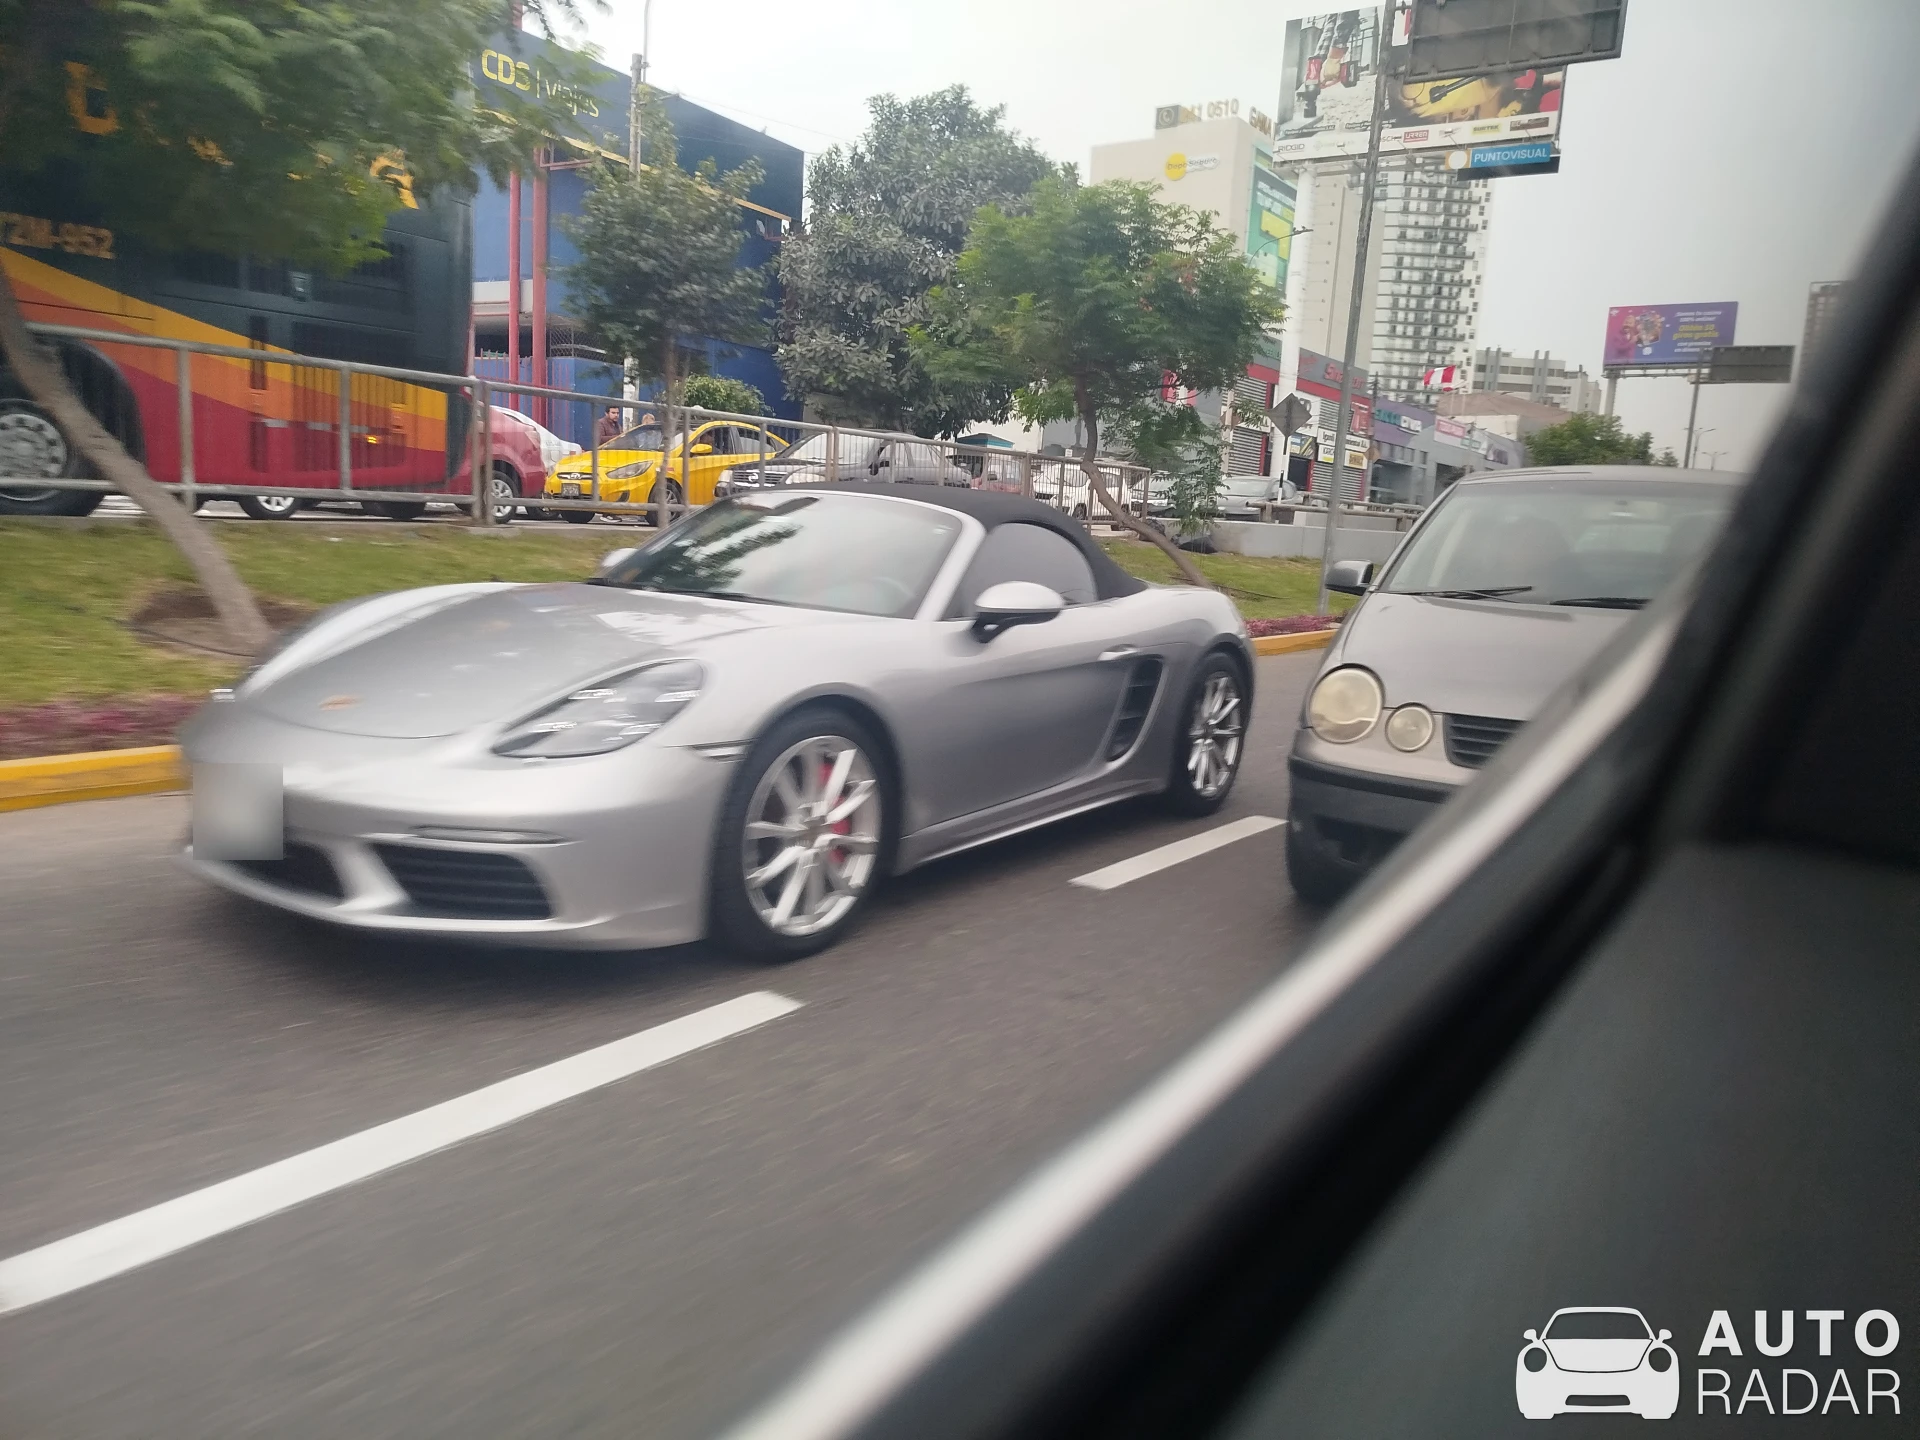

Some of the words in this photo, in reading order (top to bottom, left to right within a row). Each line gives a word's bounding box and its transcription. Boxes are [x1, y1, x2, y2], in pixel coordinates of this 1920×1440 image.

[481, 49, 531, 91] CDS
[1278, 143, 1306, 152] RIDGID
[1474, 148, 1548, 163] PUNTOVISUAL
